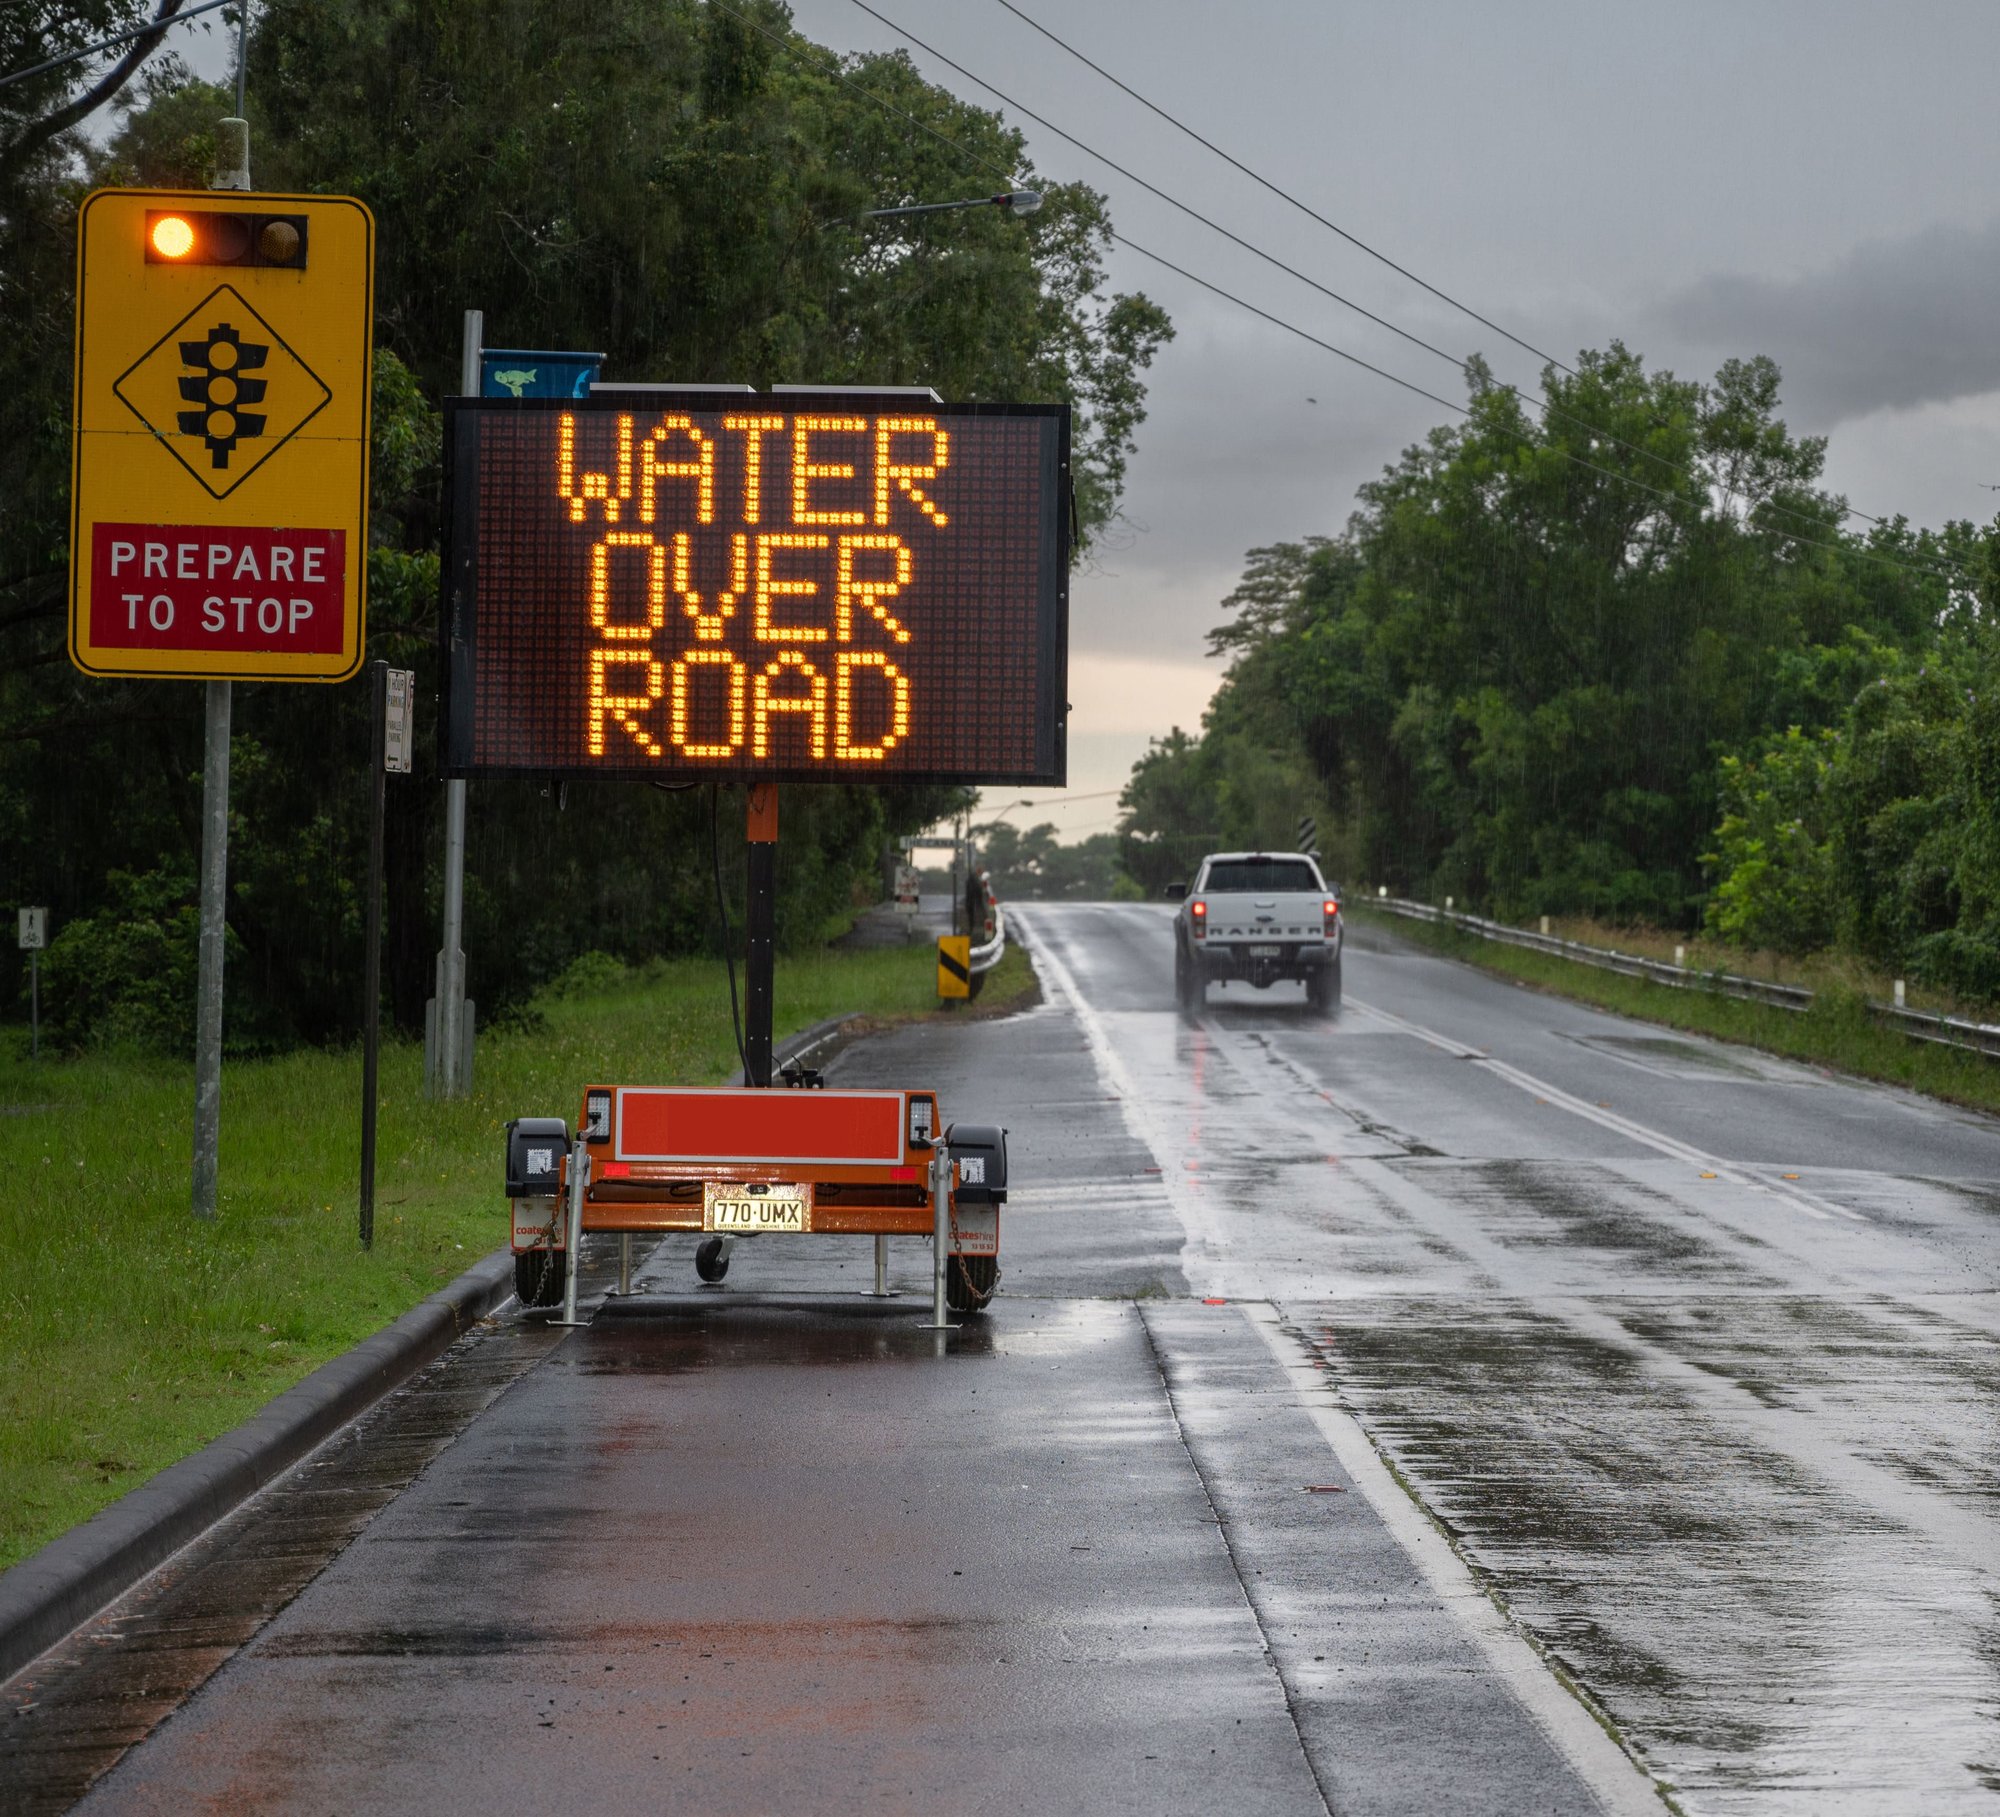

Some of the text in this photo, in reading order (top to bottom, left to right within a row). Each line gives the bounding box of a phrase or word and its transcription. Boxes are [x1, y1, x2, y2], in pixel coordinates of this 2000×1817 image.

[558, 413, 949, 525] WATER
[111, 541, 325, 583] PREPARE
[590, 533, 911, 643] OVER
[121, 594, 314, 634] TO STOP
[387, 694, 404, 708] PARKING
[392, 678, 404, 691] HOUR
[588, 649, 910, 759] ROAD
[1209, 927, 1321, 936] RANGER
